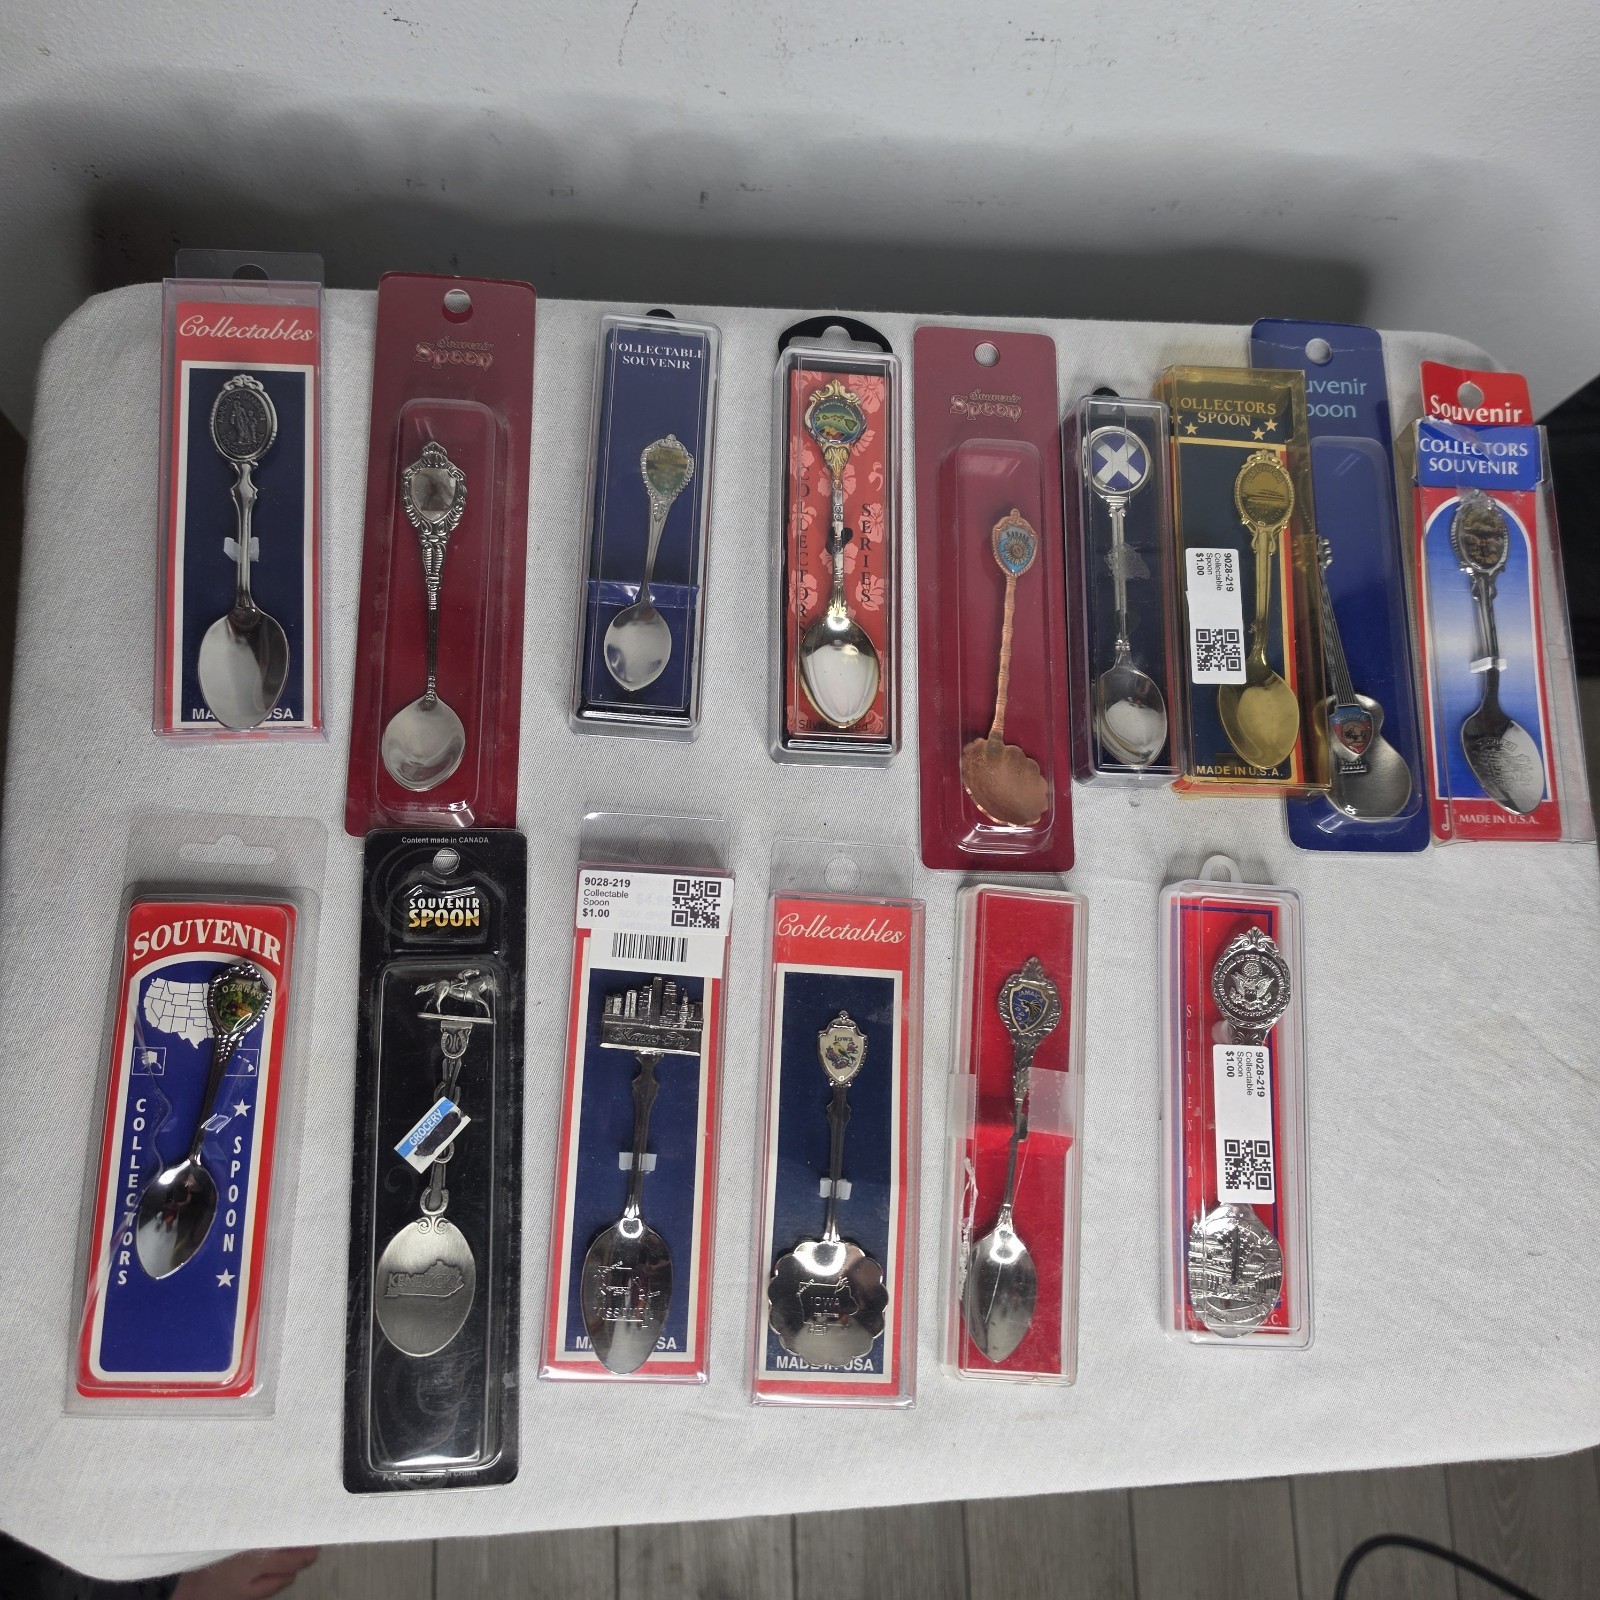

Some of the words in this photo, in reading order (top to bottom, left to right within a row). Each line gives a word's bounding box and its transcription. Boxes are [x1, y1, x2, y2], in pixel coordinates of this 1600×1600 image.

[179, 314, 315, 342] Collectables
[437, 335, 495, 351] Souvenir
[610, 342, 706, 359] COLLECTABLE
[414, 342, 495, 371] Spoon
[622, 355, 691, 370] SOUVENIR
[970, 388, 1022, 403] Souvenir
[1305, 378, 1367, 395] uvenir
[950, 394, 1022, 422] Spoon
[1170, 397, 1277, 416] COLLECTORS
[1430, 395, 1523, 424] Souvenir
[1197, 412, 1251, 427] SPOON
[1419, 437, 1528, 457] COLLECTORS
[1428, 458, 1519, 475] SOUVENIR
[860, 503, 871, 602] SERIES
[1195, 552, 1205, 576] $1.00
[1205, 552, 1213, 575] Spoon
[1214, 552, 1222, 591] Collectable
[1224, 552, 1234, 592] 9028-219
[1196, 765, 1231, 775] MADE
[1234, 766, 1246, 776] IN
[1248, 766, 1284, 777] U.S.A.
[1459, 814, 1491, 824] MADE
[1493, 814, 1505, 824] IN
[1508, 815, 1539, 825] U.S.A.
[401, 836, 429, 844] Content
[430, 836, 449, 844] made
[458, 836, 489, 844] CANADA
[584, 877, 631, 888] 9028-219
[409, 898, 480, 909] SOUVENIR
[582, 898, 610, 907] Spoon
[583, 889, 629, 899] Collectable
[408, 909, 480, 928] SPOON
[582, 908, 610, 918] $1.00
[777, 912, 906, 944] Collectables
[132, 918, 281, 966] SOUVENIR
[222, 983, 266, 1000] OZARKS
[1018, 989, 1044, 1004] JAMAICA
[833, 1034, 853, 1042] Iowa
[1225, 1050, 1235, 1078] $1.00
[1236, 1051, 1244, 1077] Spoon
[1245, 1051, 1253, 1096] Collectable
[1255, 1051, 1266, 1098] 9028-219
[409, 1108, 443, 1146] GROCERY
[117, 1098, 147, 1285] COLLECTORS
[223, 1135, 242, 1253] SPOON
[810, 1296, 840, 1306] IOWA
[382, 1473, 421, 1482] Packaging
[453, 1469, 478, 1477] CHINA
